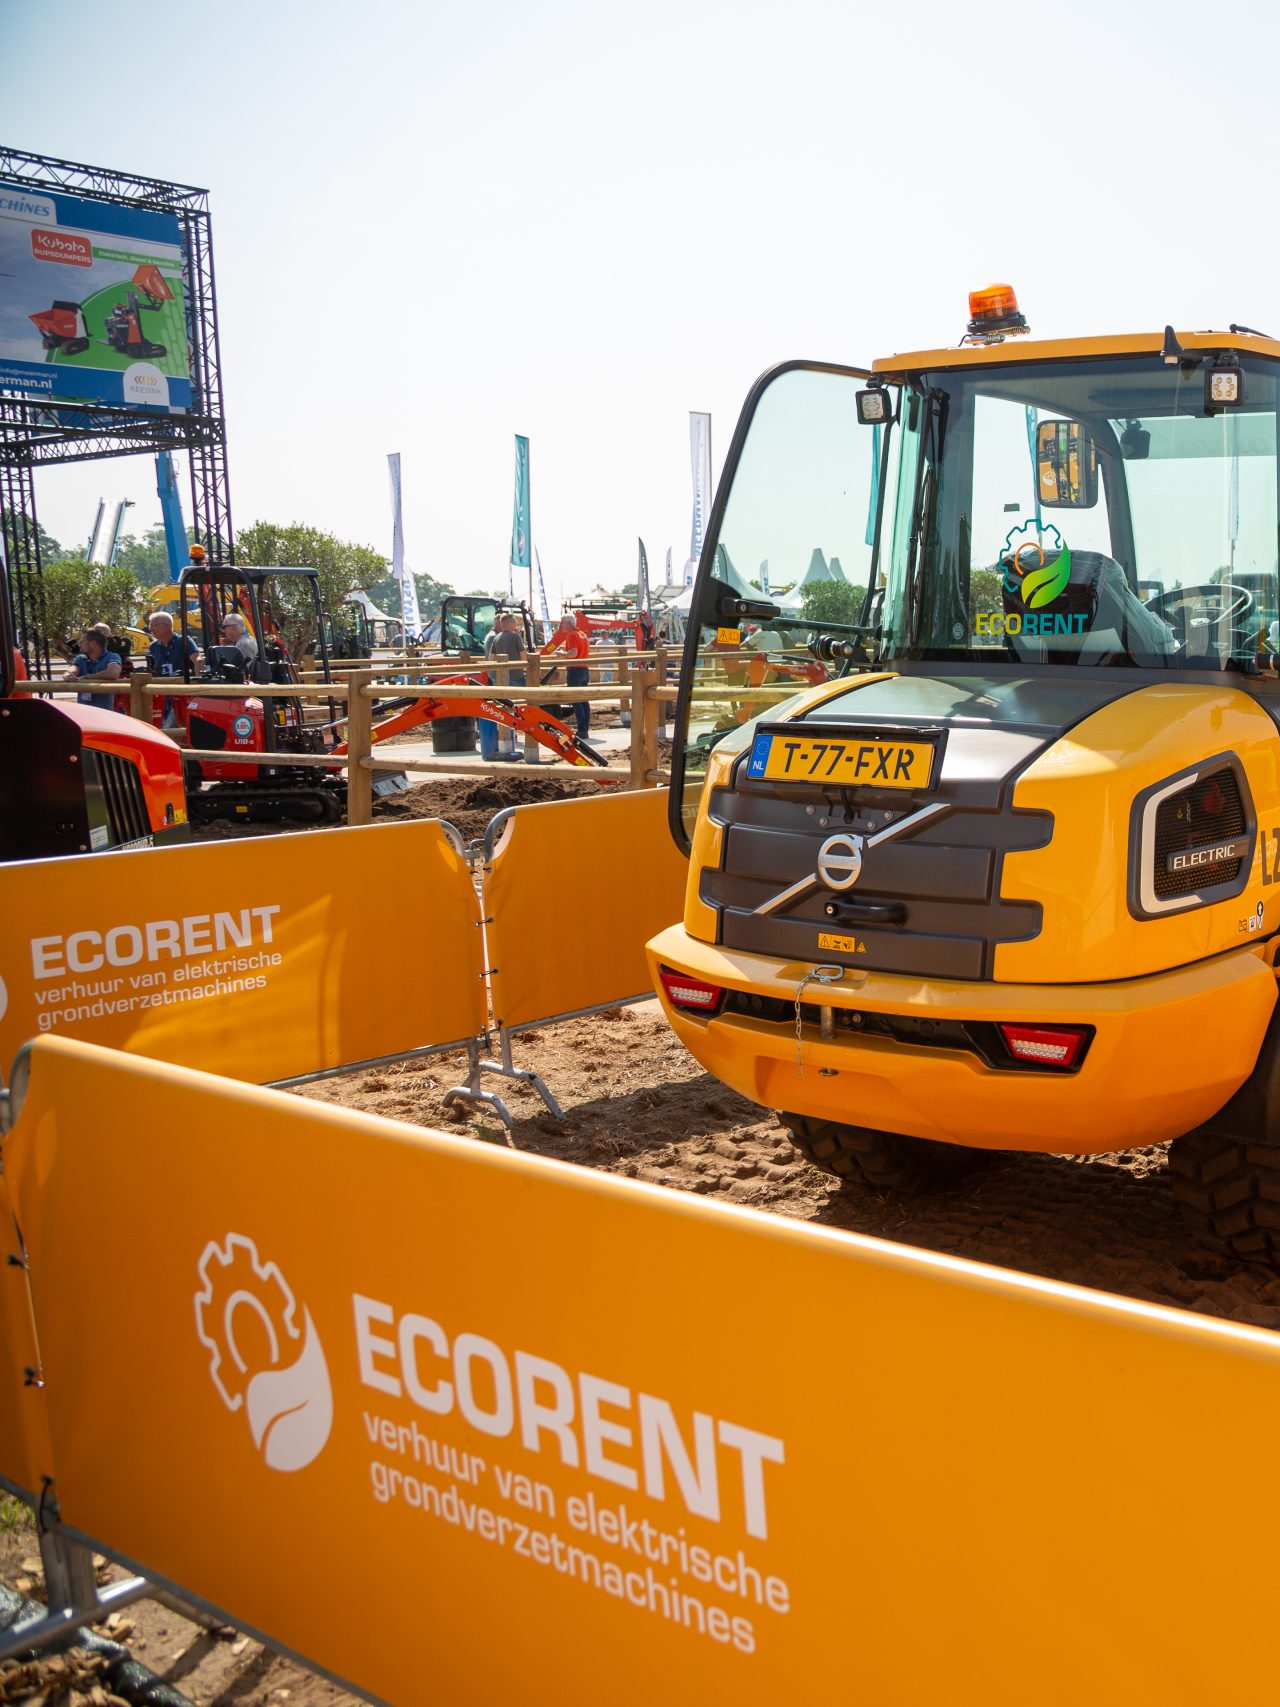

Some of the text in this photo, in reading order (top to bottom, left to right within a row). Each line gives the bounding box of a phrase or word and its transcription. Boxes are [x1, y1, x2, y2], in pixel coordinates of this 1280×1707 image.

[34, 248, 91, 263] RUPSDUMPERS
[38, 235, 86, 253] Kubota
[975, 613, 1088, 636] ECORENT
[480, 702, 505, 720] Kubota
[753, 742, 915, 781] NL T-77-FXR
[1173, 844, 1235, 870] ELECTRIC
[30, 905, 281, 979] ECORENT
[34, 950, 282, 1005] verhuur van elektrische
[37, 973, 267, 1031] grondverzetmachines
[352, 1293, 785, 1540] ECORENT
[363, 1411, 789, 1613] verhuur van elektrische
[370, 1460, 756, 1654] grondverzetmachines
